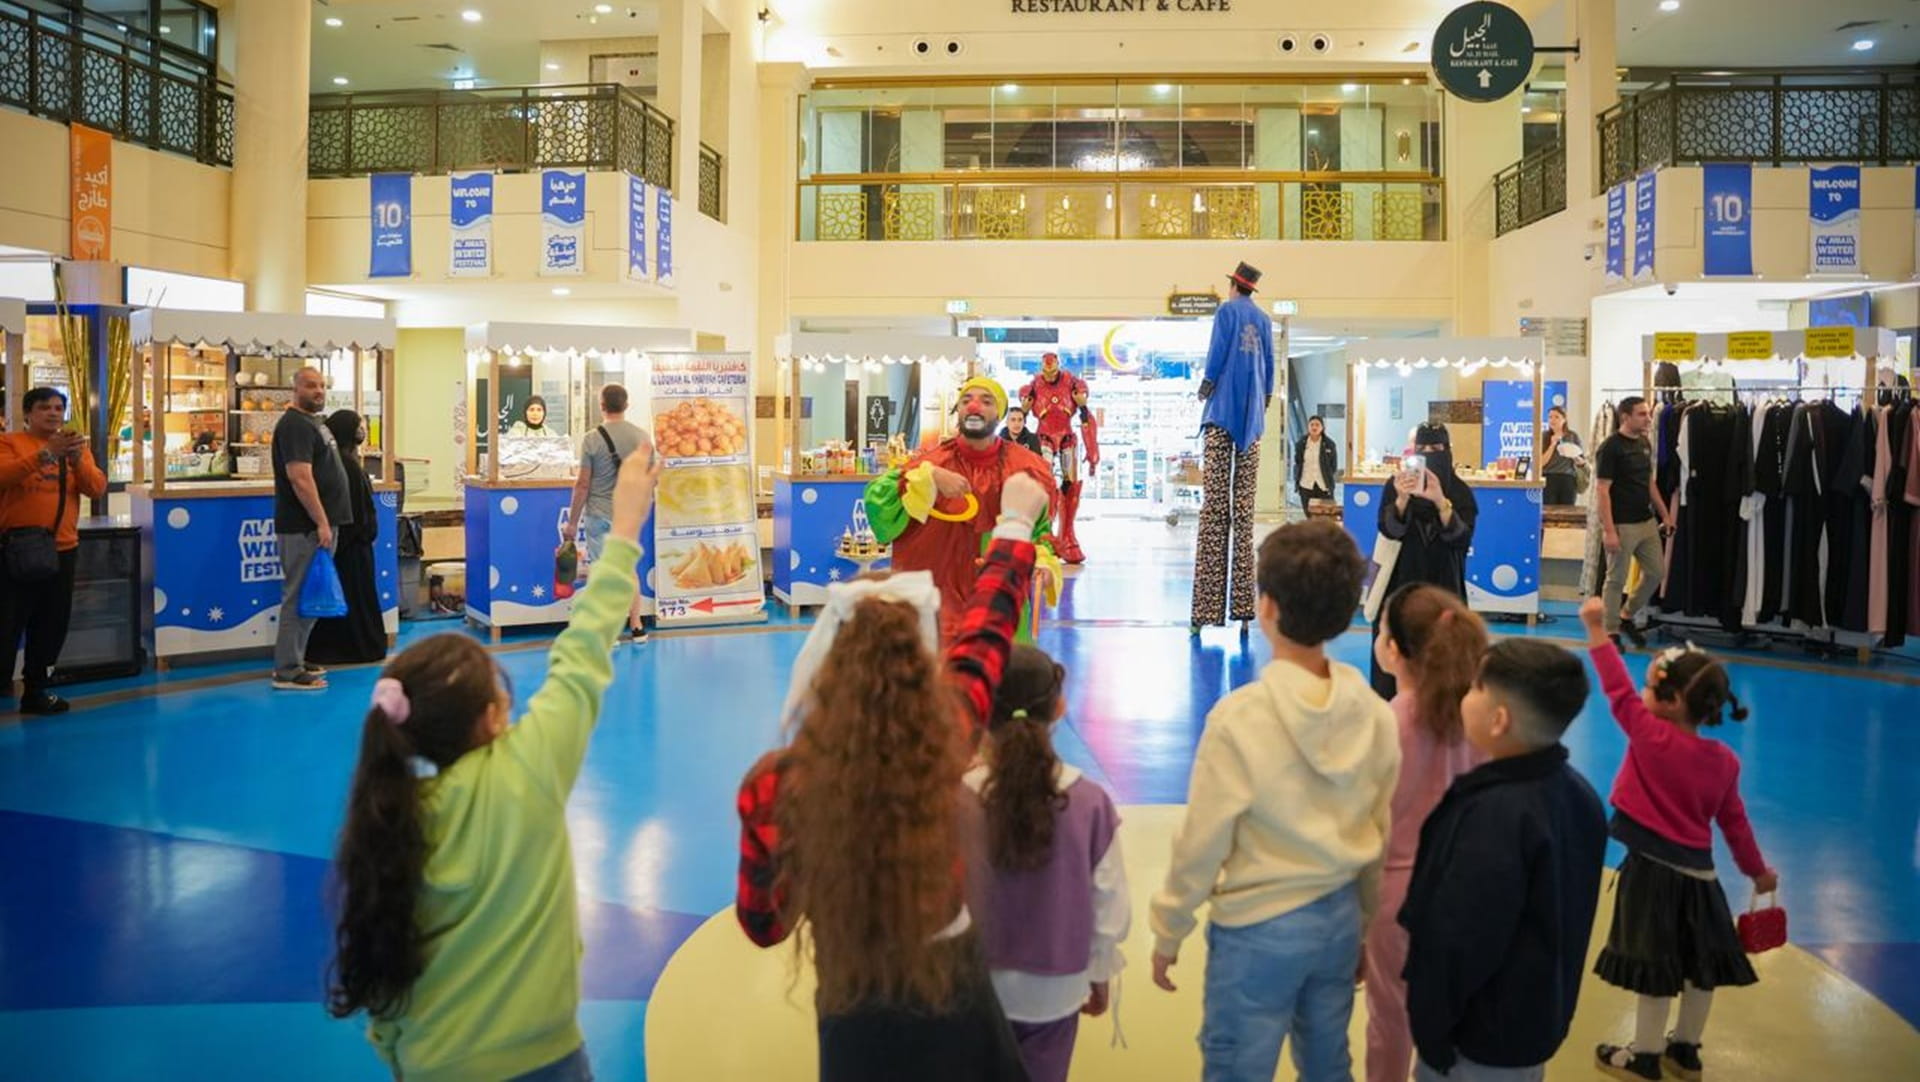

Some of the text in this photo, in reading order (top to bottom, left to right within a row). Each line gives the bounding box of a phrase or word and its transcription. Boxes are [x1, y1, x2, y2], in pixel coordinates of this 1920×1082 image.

[1011, 0, 1147, 13] RESTAURANT
[1156, 0, 1169, 12] &
[1449, 13, 1491, 57] الجبيل
[1813, 180, 1858, 189] WELCOME
[453, 187, 491, 197] WELCOME
[1828, 193, 1842, 202] TO
[1712, 195, 1743, 222] 10
[376, 203, 402, 229] 10
[1502, 423, 1515, 433] AL
[243, 523, 262, 536] AL
[244, 562, 282, 579] FEST
[660, 606, 686, 617] 173
